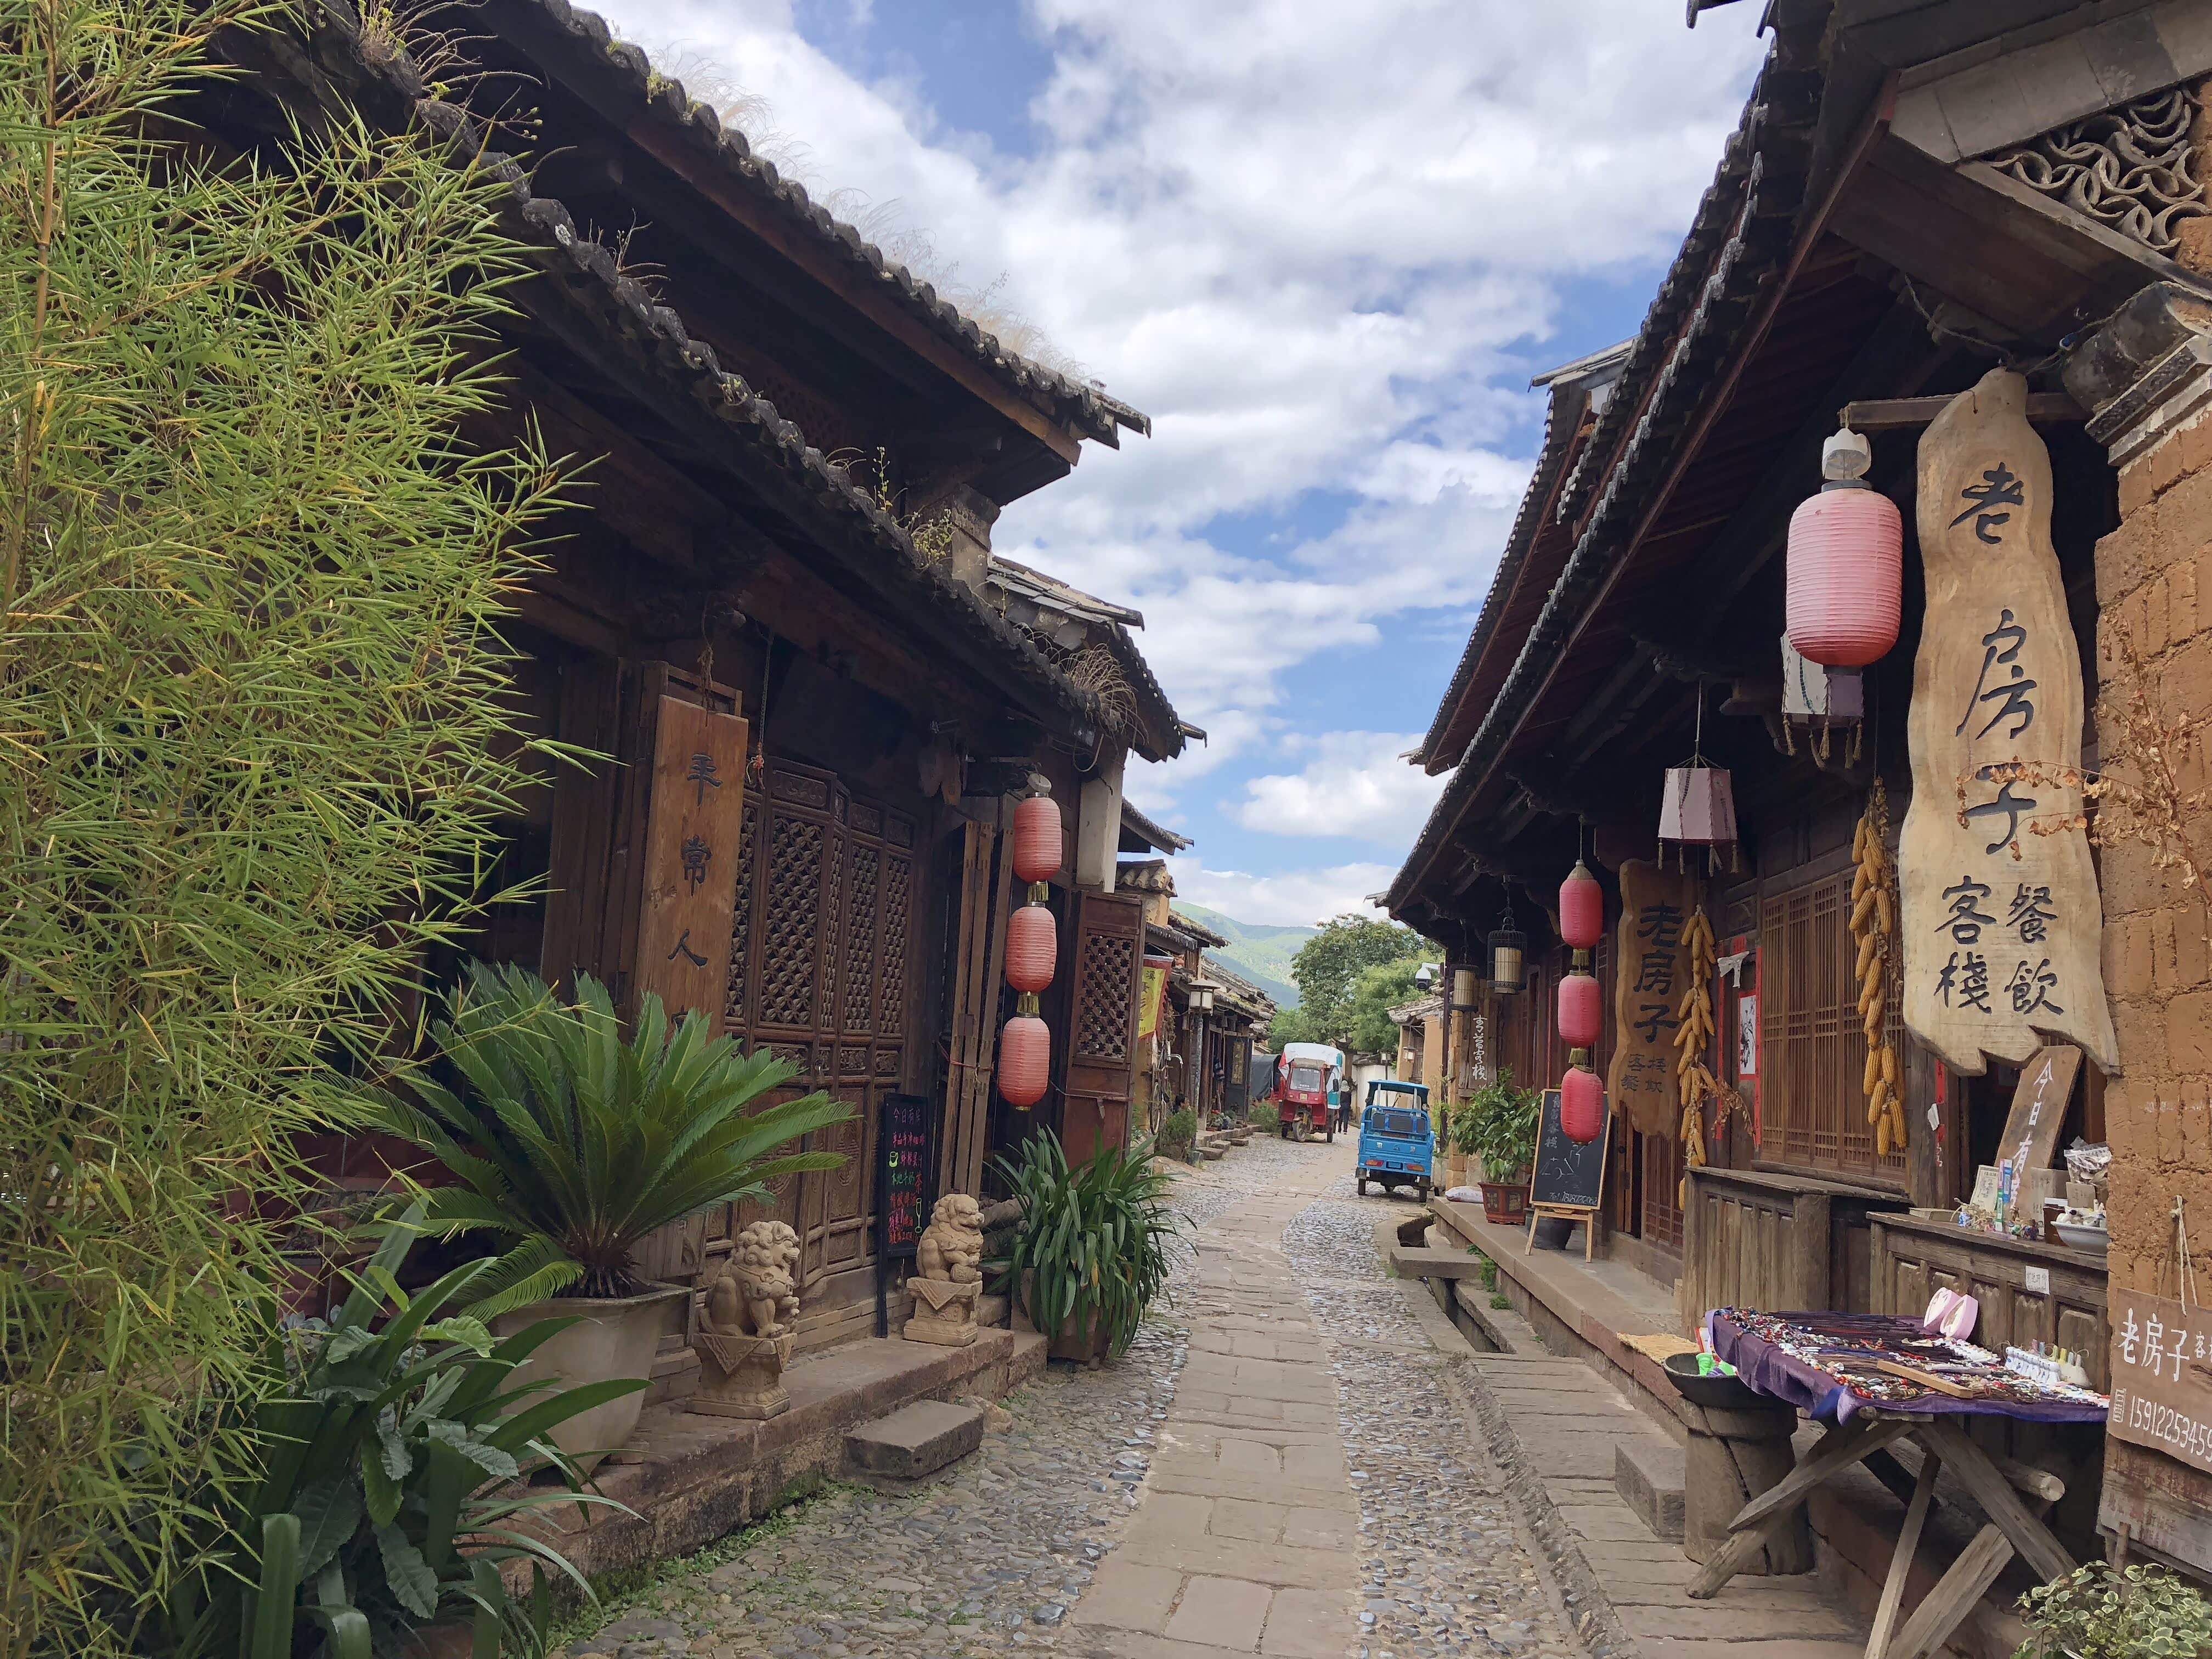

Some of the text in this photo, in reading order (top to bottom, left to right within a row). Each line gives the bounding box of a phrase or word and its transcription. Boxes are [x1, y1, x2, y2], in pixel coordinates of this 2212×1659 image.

[1948, 462, 2037, 856] 老房子
[1632, 900, 1684, 1043] 老房子
